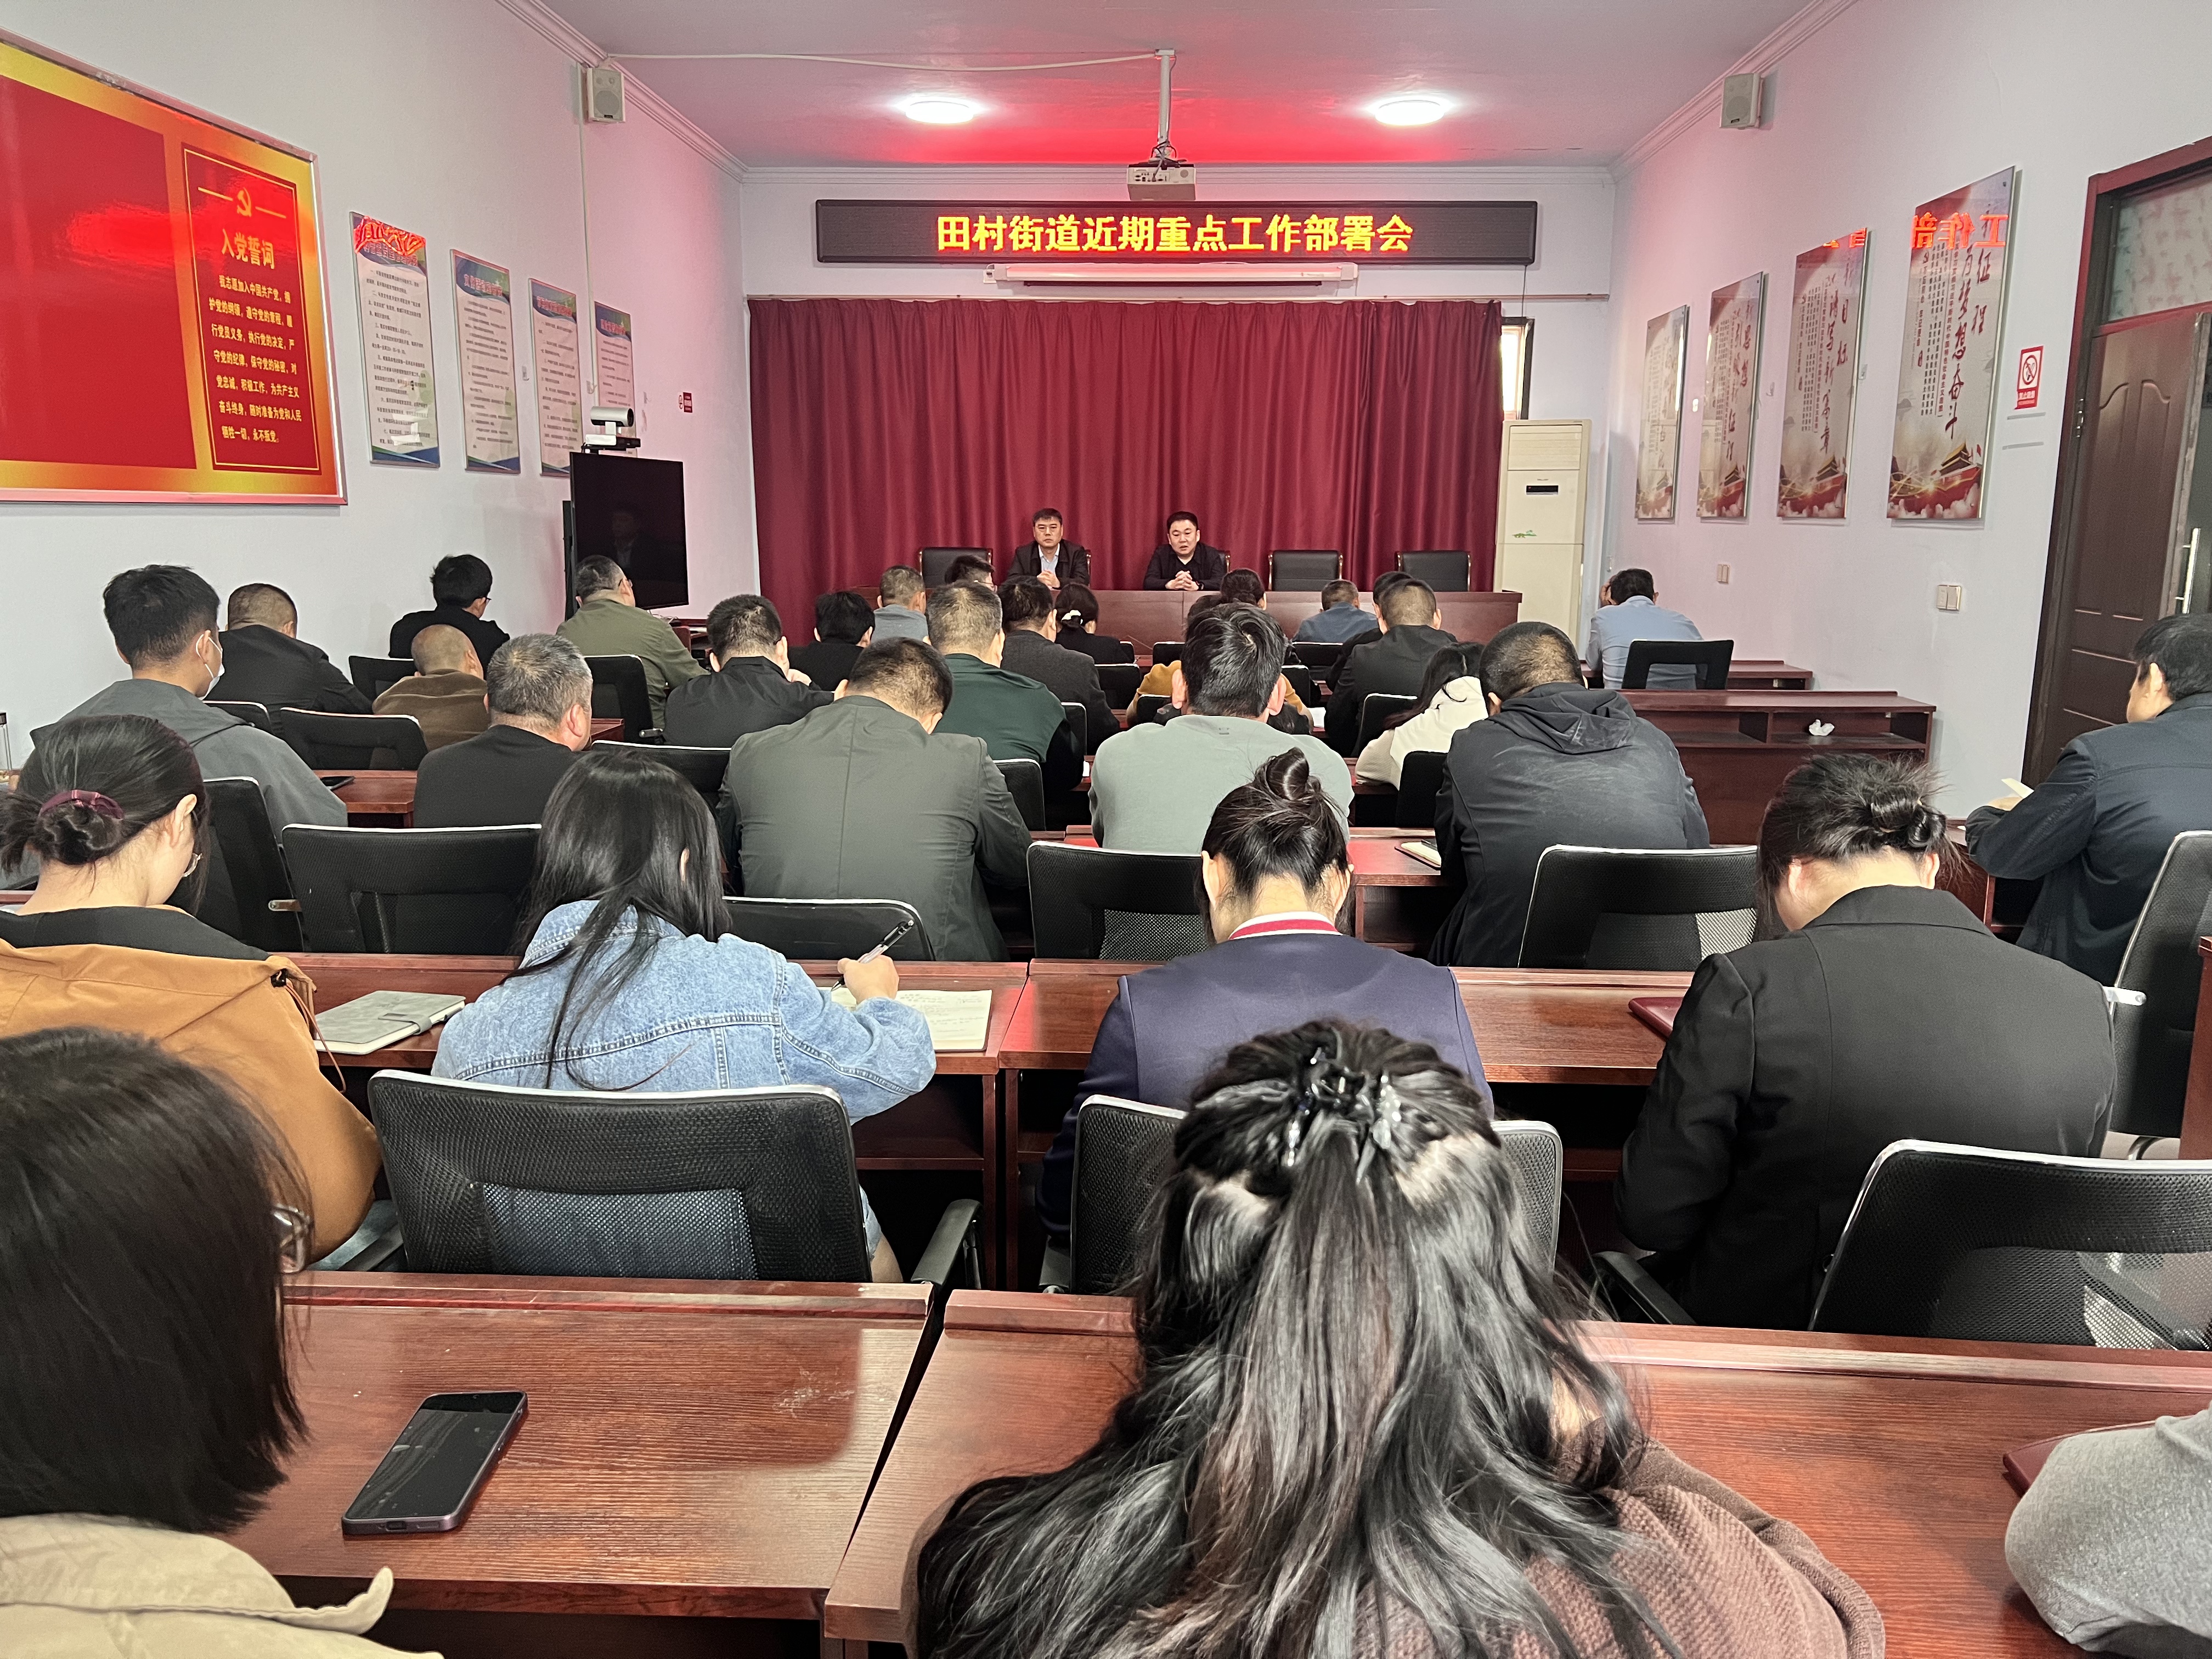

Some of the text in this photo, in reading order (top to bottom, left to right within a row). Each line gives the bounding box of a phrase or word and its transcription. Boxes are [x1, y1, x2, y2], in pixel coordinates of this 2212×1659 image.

[222, 229, 275, 269] 入党誓词
[936, 214, 1414, 253] 田村街道近期重点工作部署会
